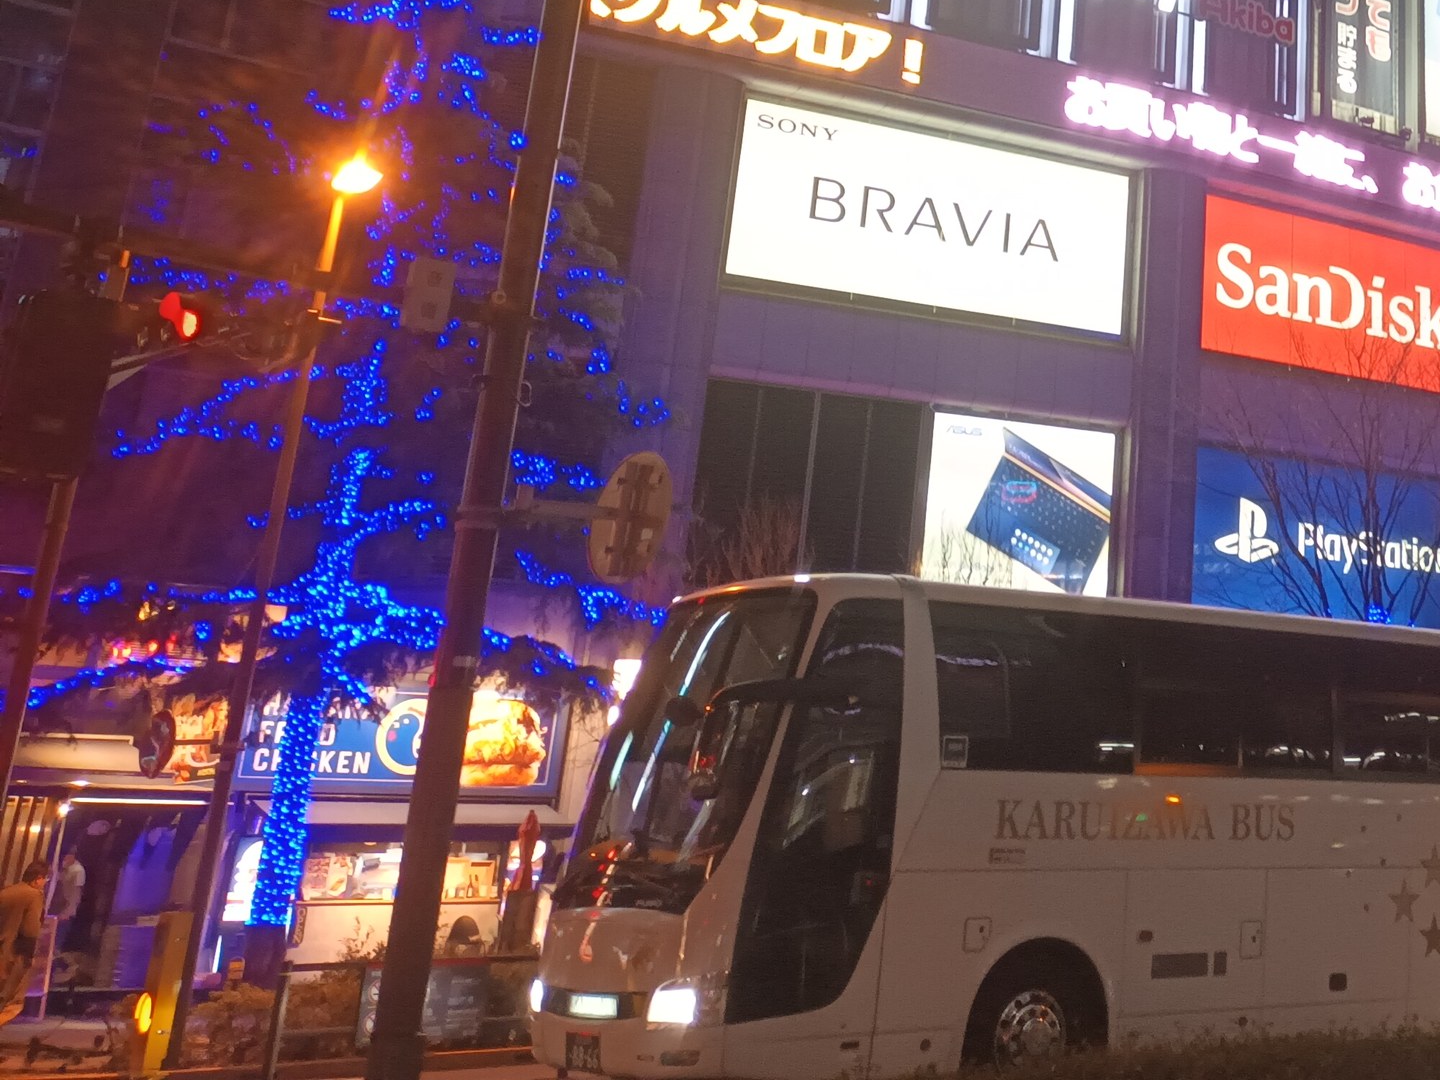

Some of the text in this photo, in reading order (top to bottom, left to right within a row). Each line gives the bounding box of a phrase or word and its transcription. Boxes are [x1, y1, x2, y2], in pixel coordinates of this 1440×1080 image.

[756, 113, 840, 142] SONY
[808, 175, 1060, 263] BRAVIA
[946, 424, 983, 437] ASUS
[252, 747, 372, 775] CKEN
[993, 797, 1297, 843] KARUIZAWA BUS
